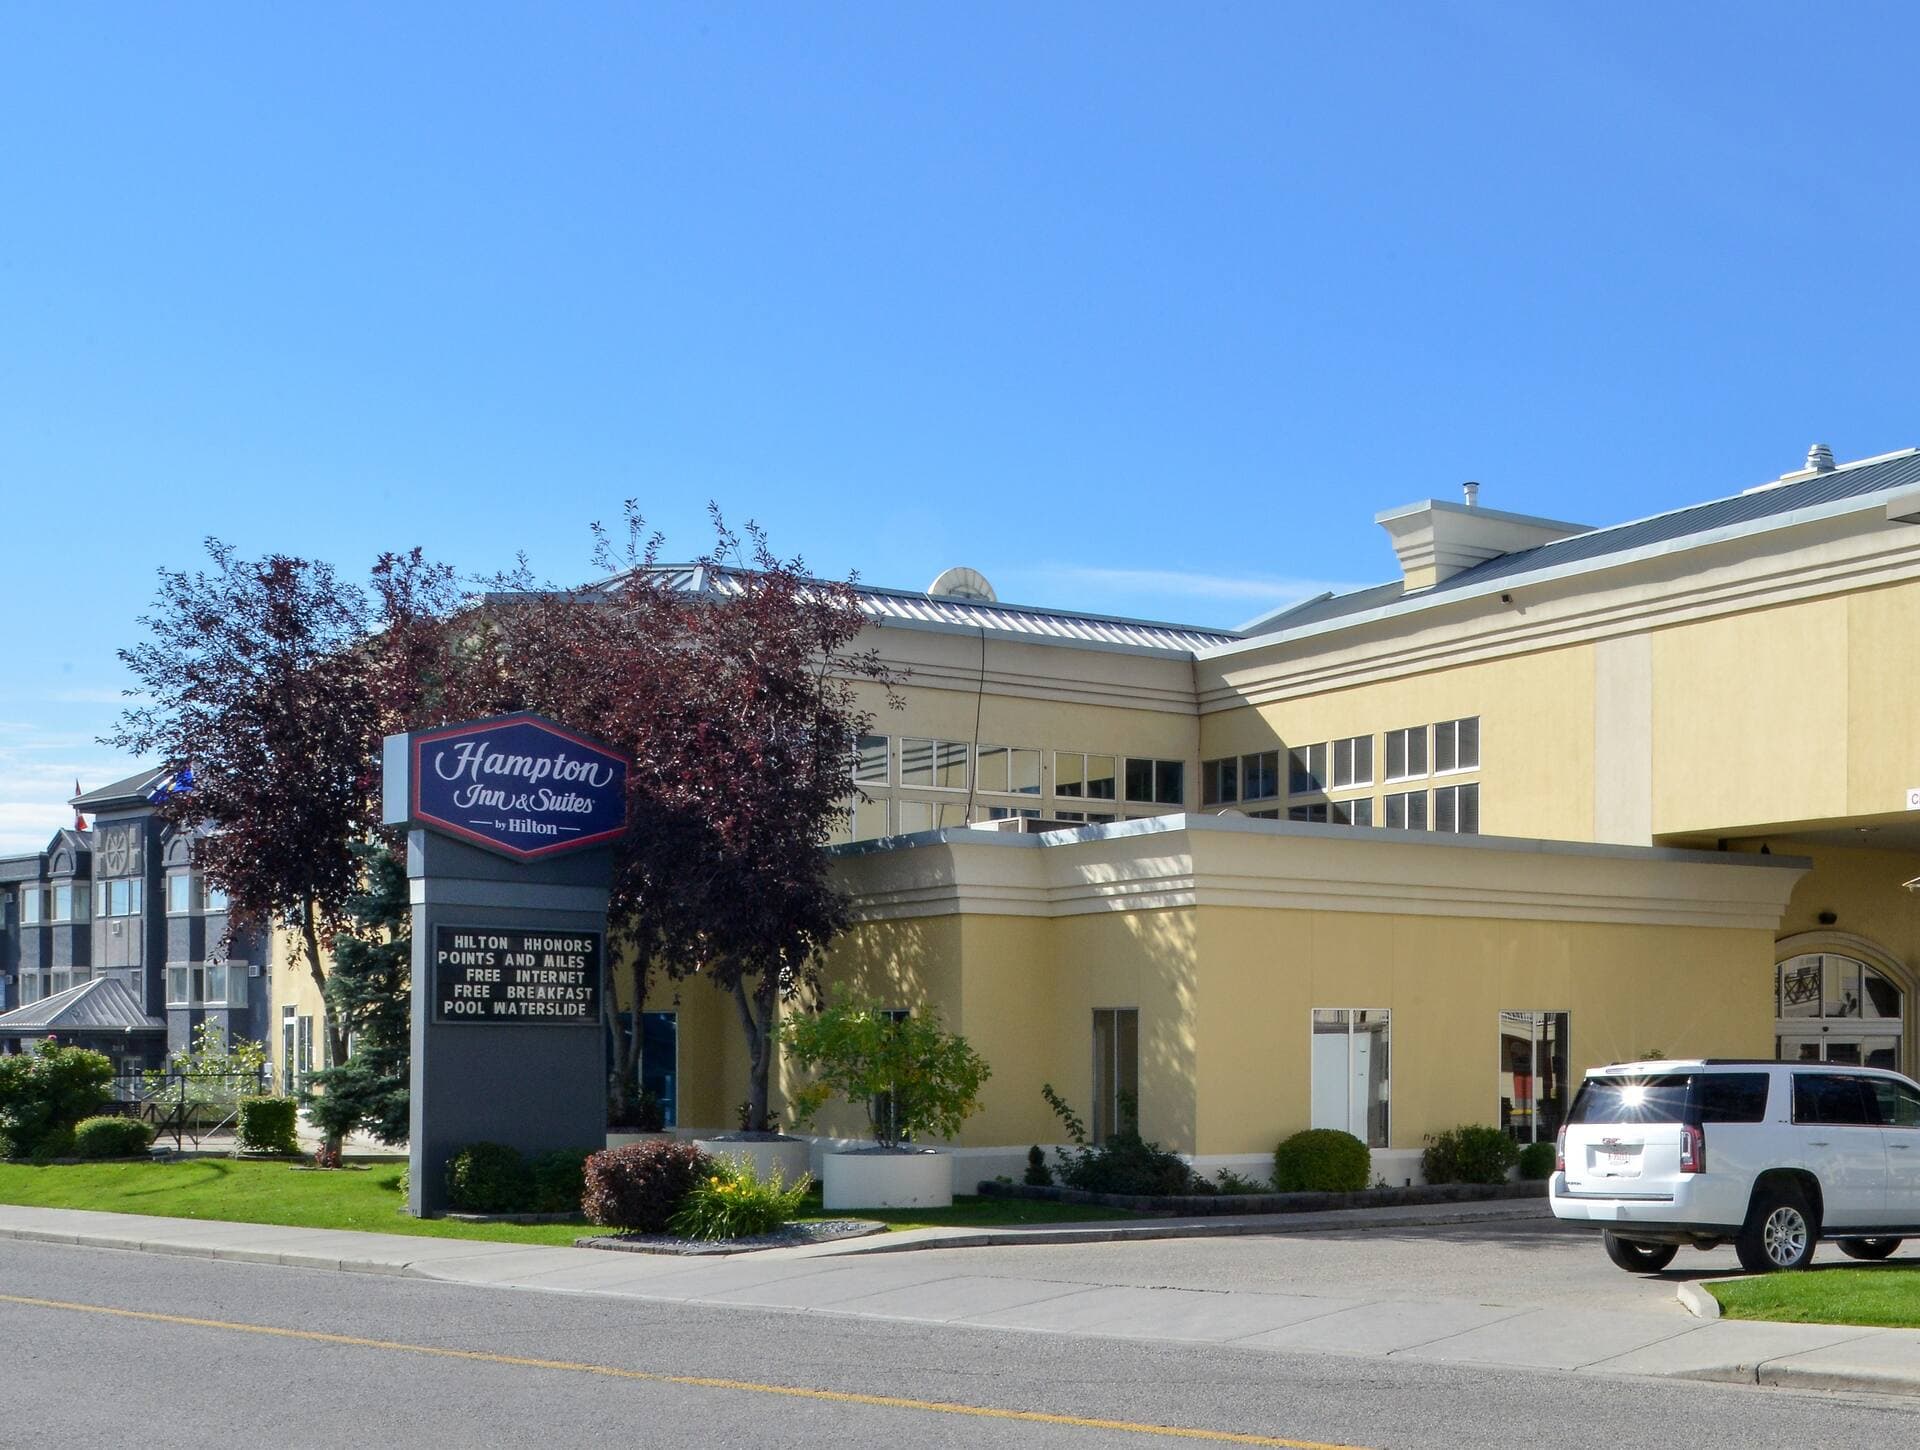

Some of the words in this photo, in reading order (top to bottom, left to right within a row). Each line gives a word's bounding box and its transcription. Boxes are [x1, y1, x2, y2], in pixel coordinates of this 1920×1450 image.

[435, 742, 613, 788] Hampton
[453, 784, 516, 811] Inn
[515, 794, 532, 812] &
[529, 788, 594, 814] Suites
[495, 820, 507, 831] by
[509, 818, 557, 835] Hilton
[454, 935, 508, 950] HILTON
[524, 938, 593, 953] HHONORS
[438, 951, 495, 965] POINTS
[504, 953, 535, 967] AND
[543, 955, 585, 968] MILES
[466, 968, 500, 982] FREE
[516, 970, 585, 984] INTERNET
[454, 984, 490, 998] FREE
[507, 985, 593, 1000] BREAKFAST
[444, 1000, 485, 1015] POOL
[493, 1001, 586, 1016] WATERSLIDE
